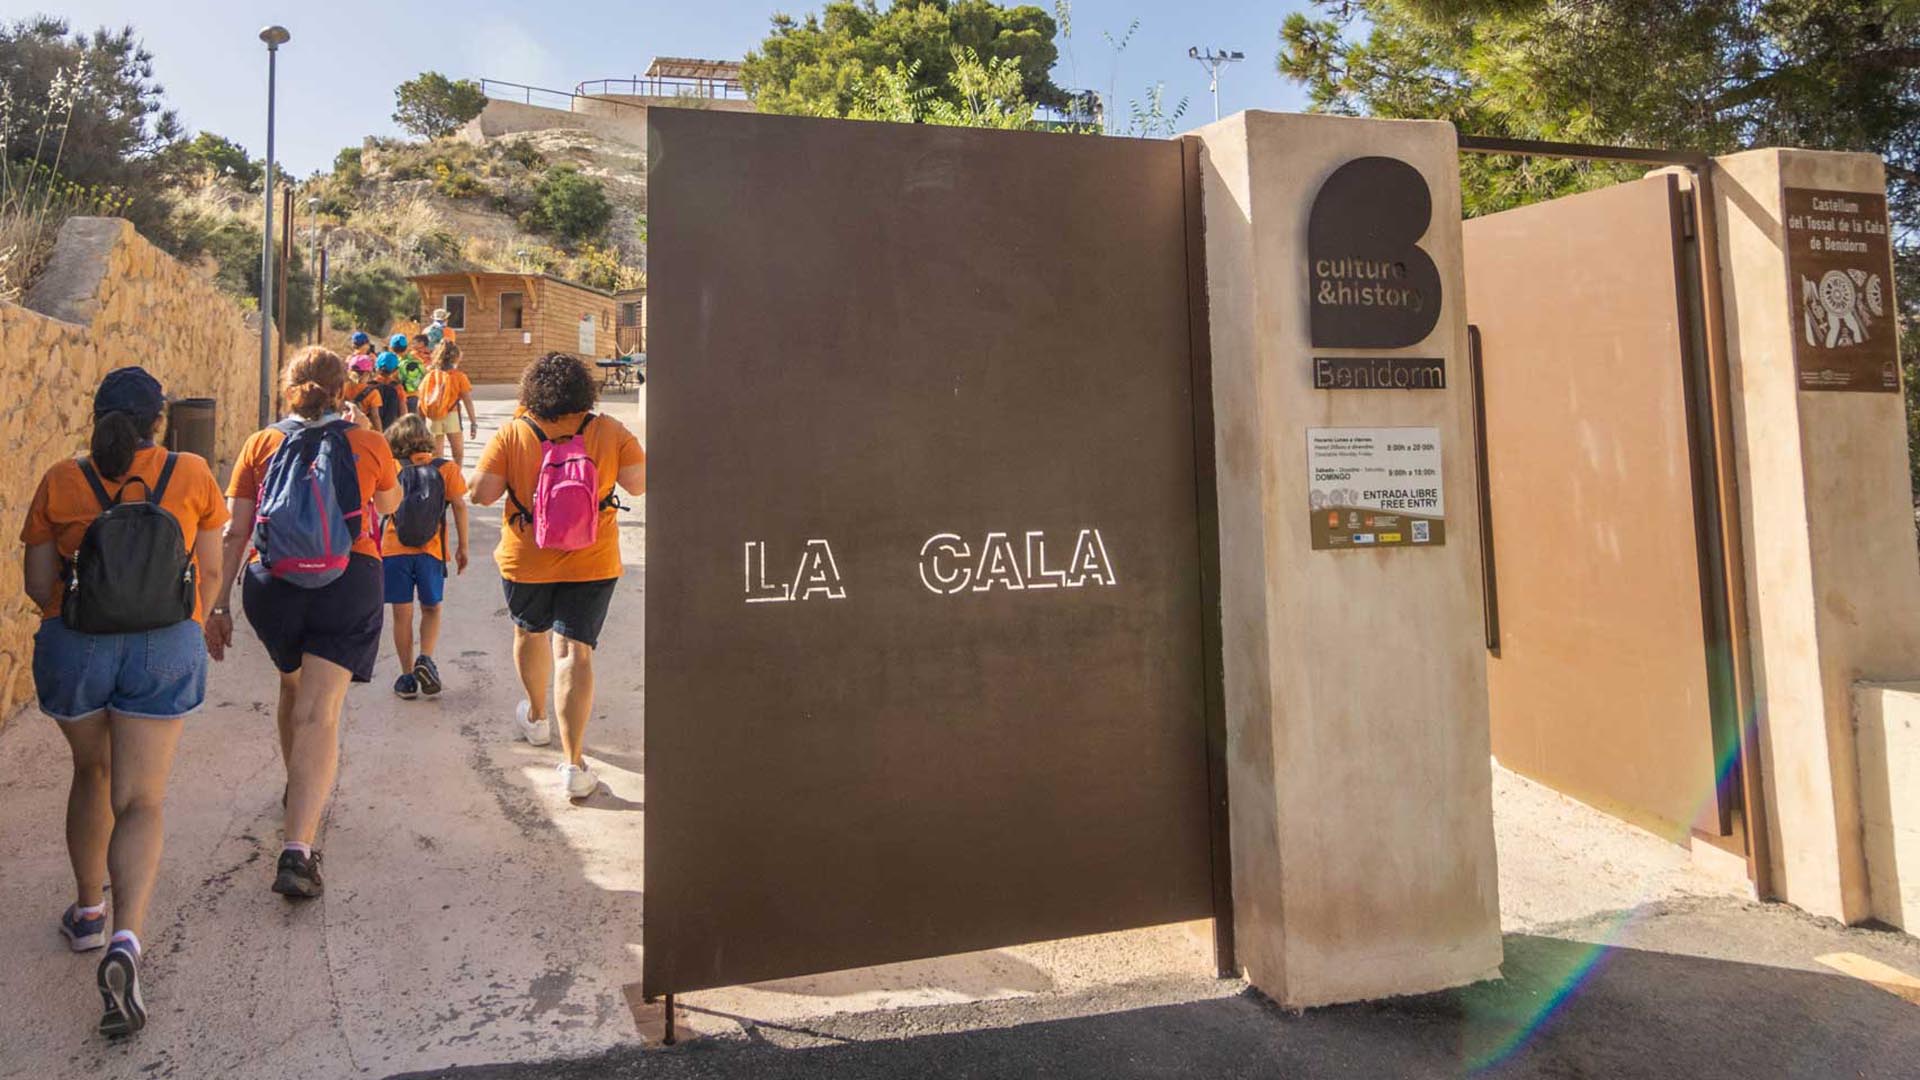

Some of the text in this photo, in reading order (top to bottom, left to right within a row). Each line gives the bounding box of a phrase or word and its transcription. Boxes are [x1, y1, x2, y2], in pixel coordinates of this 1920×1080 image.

[1812, 197, 1859, 213] Castellum
[1788, 216, 1885, 234] del Tossal de la Cala
[1810, 237, 1868, 252] de Benidorm
[1316, 257, 1407, 279] culture
[1317, 280, 1425, 312] &history
[1316, 360, 1443, 388] Benidorm
[1315, 473, 1351, 481] DOMINGO
[1363, 488, 1438, 500] ENTRADA LIBRE
[1380, 498, 1438, 509] FREE ENTRY
[744, 528, 1118, 604] LA CALA
